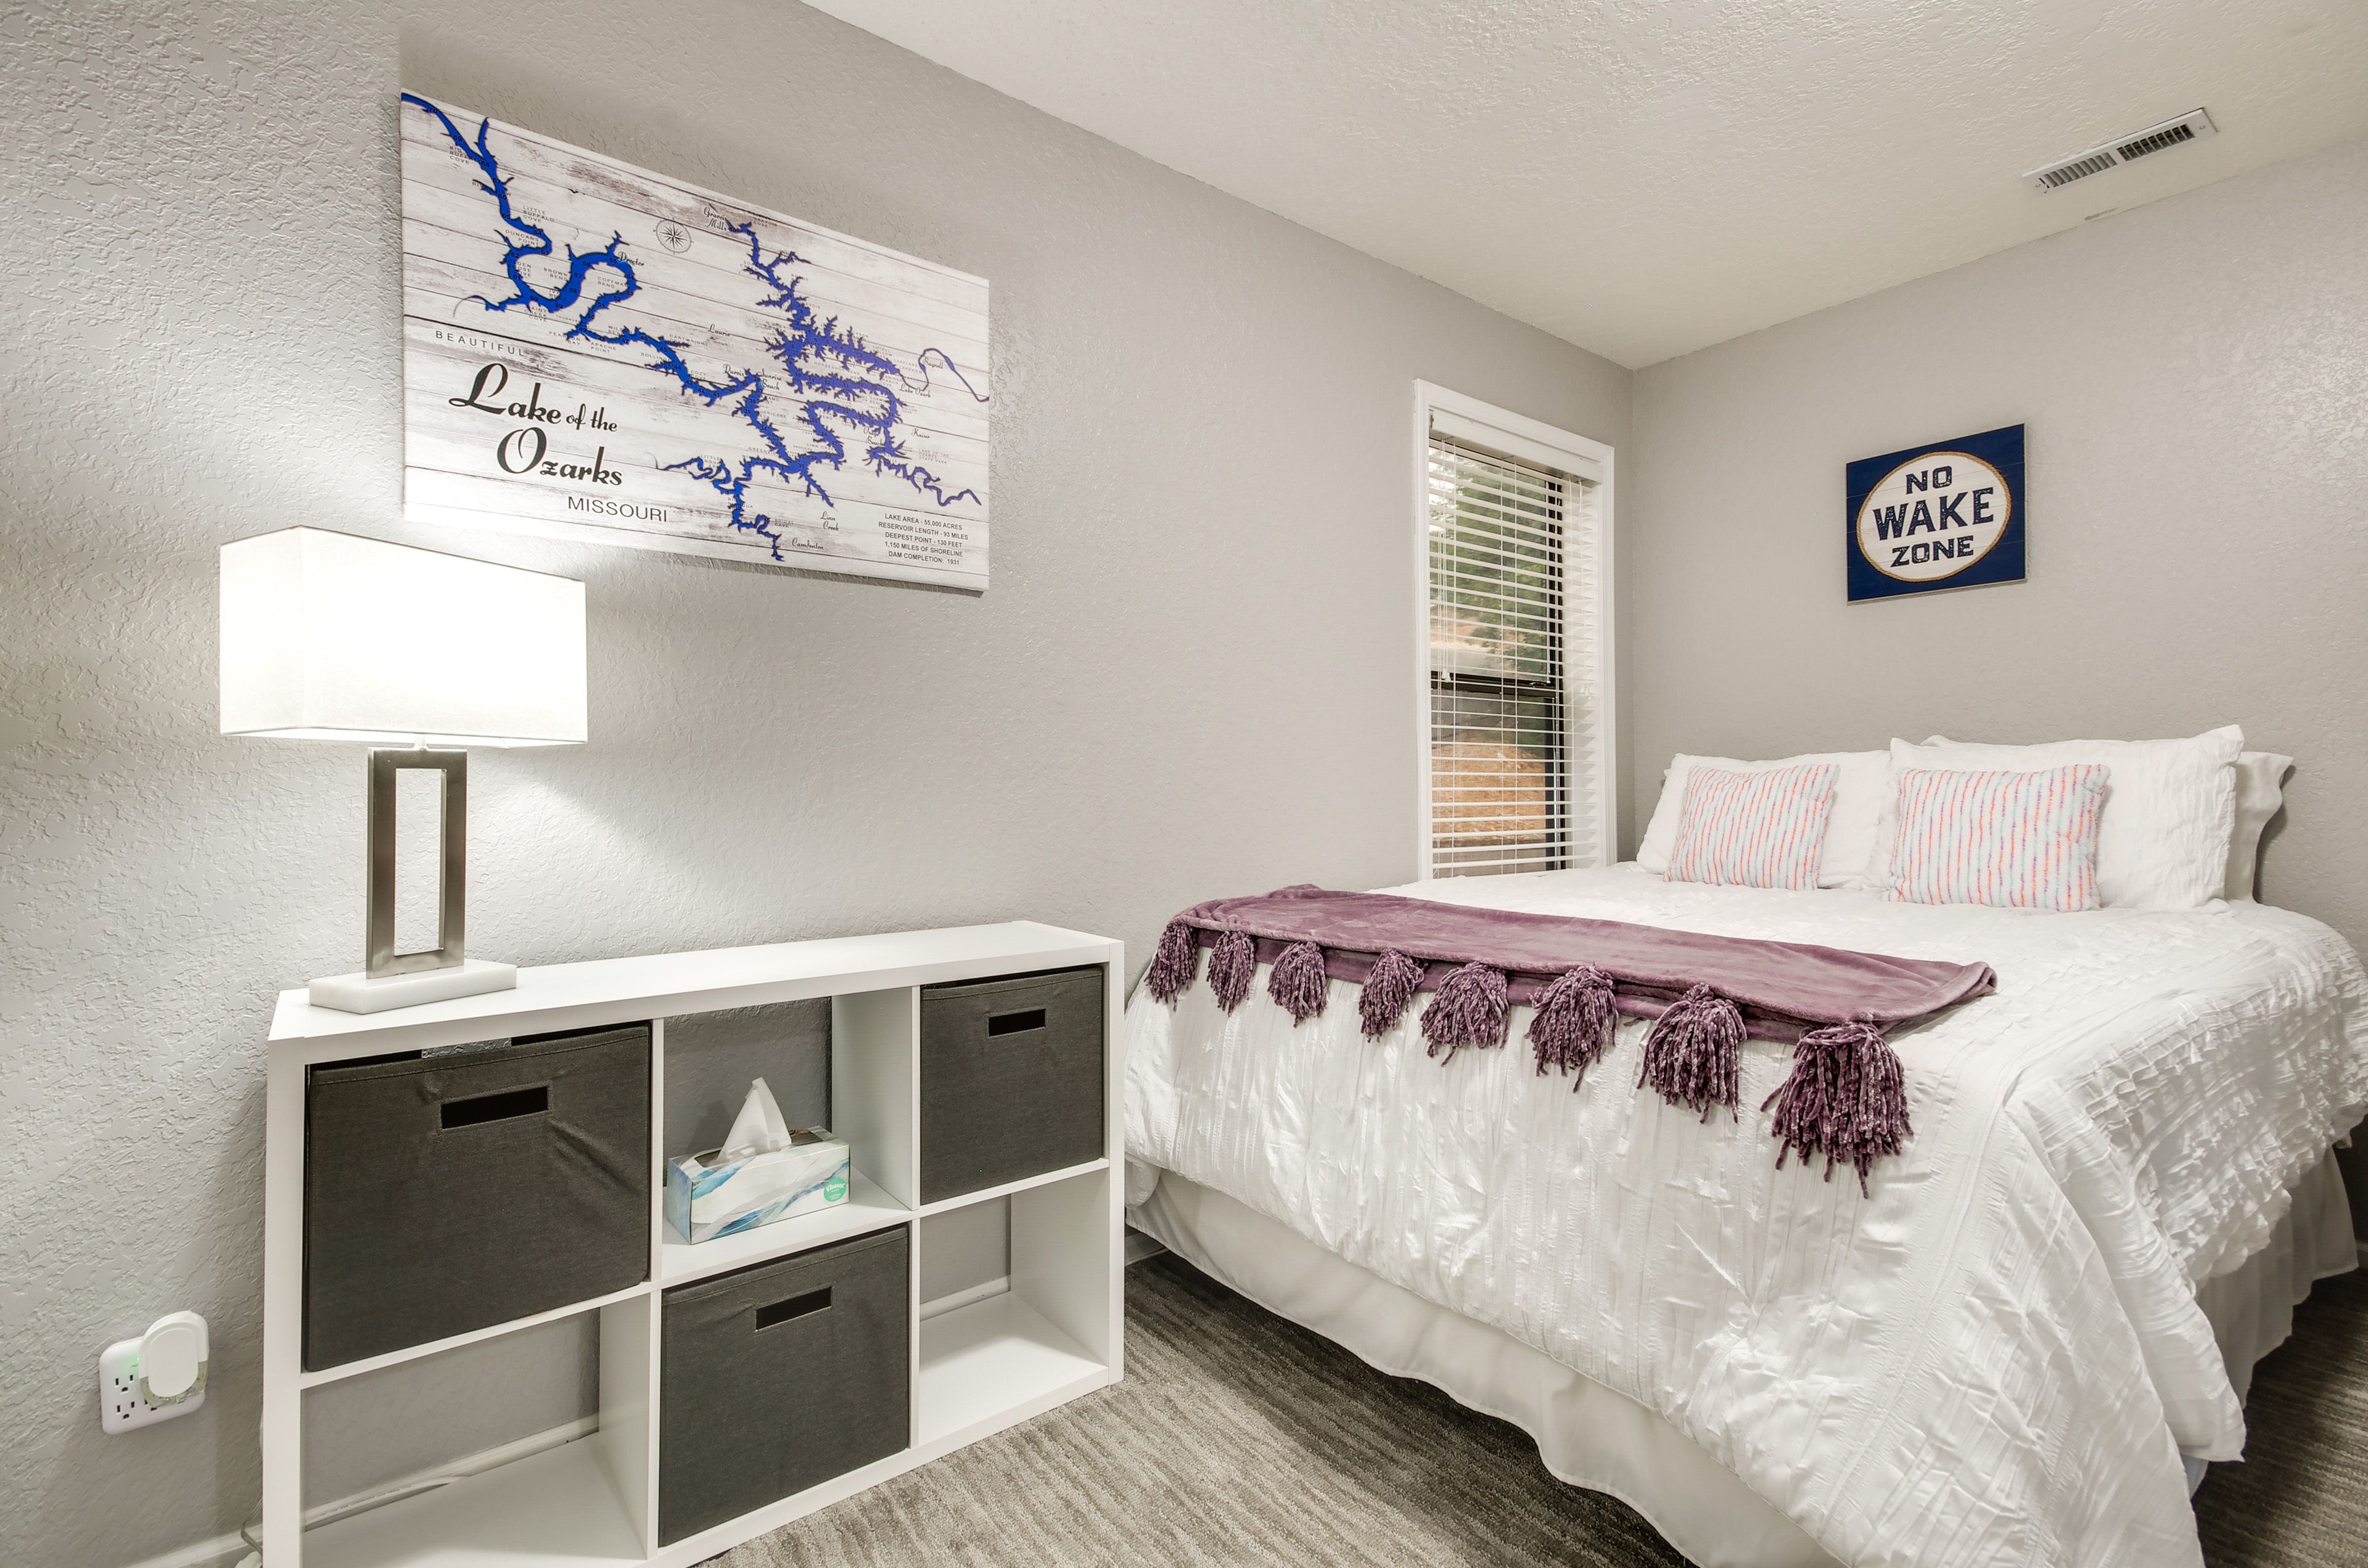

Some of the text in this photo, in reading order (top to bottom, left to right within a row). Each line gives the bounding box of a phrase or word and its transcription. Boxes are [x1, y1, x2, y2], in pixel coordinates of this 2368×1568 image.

[450, 155, 469, 164] COVE
[523, 206, 546, 215] LITTLE
[523, 210, 554, 222] BUFFALO
[506, 230, 539, 242] DUNCANS
[519, 237, 539, 247] POINT
[618, 252, 644, 266] Proctor
[544, 268, 568, 277] BROWN
[708, 324, 730, 337] Laurie
[436, 330, 525, 356] BEAUTIFUL
[591, 342, 617, 351] APACHE
[923, 358, 944, 369] Bagnell
[756, 368, 782, 381] Sunrise
[760, 378, 780, 390] Beach
[899, 384, 931, 398] Lake Ozark
[449, 363, 617, 432] Lake of the
[911, 428, 930, 439] Kaiser
[866, 435, 884, 446] Beach
[497, 427, 623, 486] Ozarks
[1906, 466, 1952, 495] NO
[569, 496, 667, 522] MISSOURI
[1873, 487, 1994, 541] WAKE
[820, 511, 836, 521] Linn
[823, 520, 839, 531] Creek
[879, 522, 913, 532] RESERVOIR
[915, 527, 939, 536] LENGTH
[924, 519, 942, 527] 55,000
[886, 532, 913, 541] DEEPEST
[792, 538, 823, 550] Camdenton
[931, 548, 963, 557] SHORELINE
[1890, 535, 1974, 567] ZONE
[904, 552, 944, 563] COMPLETION:
